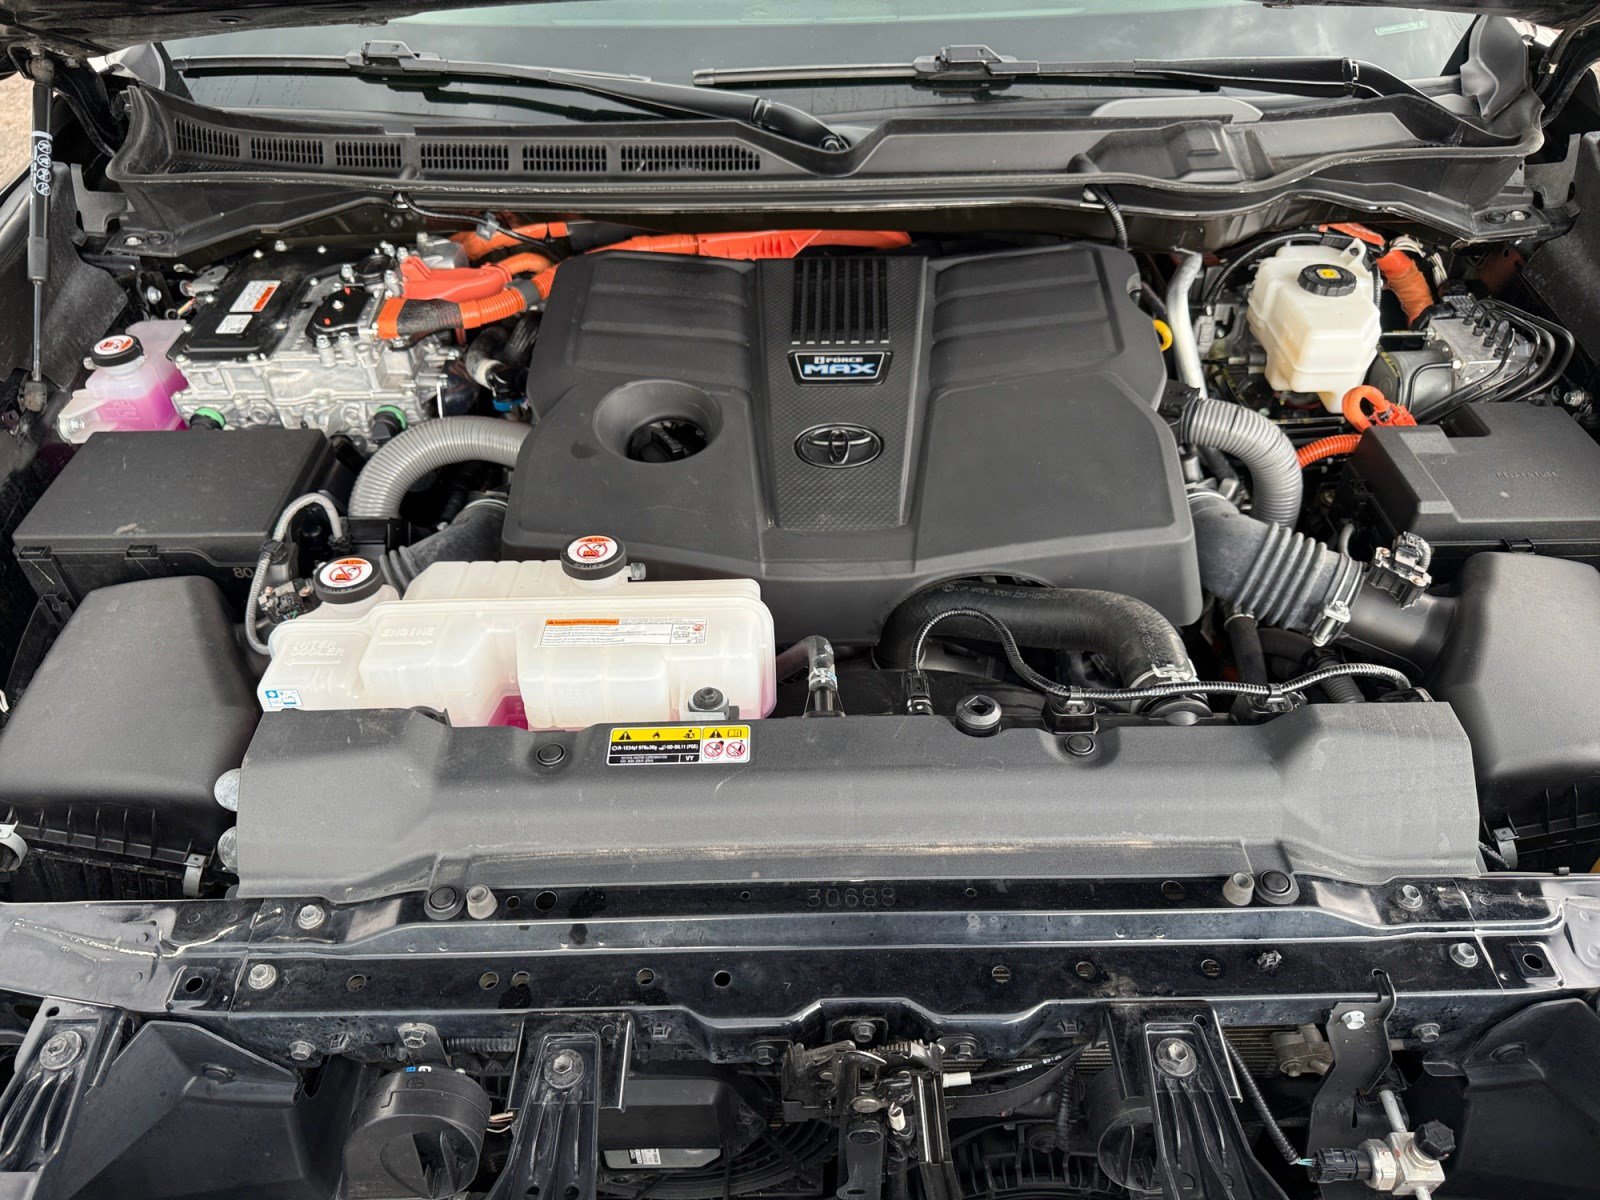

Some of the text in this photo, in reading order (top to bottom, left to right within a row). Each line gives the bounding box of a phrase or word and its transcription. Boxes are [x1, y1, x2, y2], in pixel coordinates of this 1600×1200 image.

[804, 363, 875, 374] MAX
[232, 567, 254, 579] 80
[381, 627, 435, 637] ENGINE
[806, 887, 896, 907] 30688
